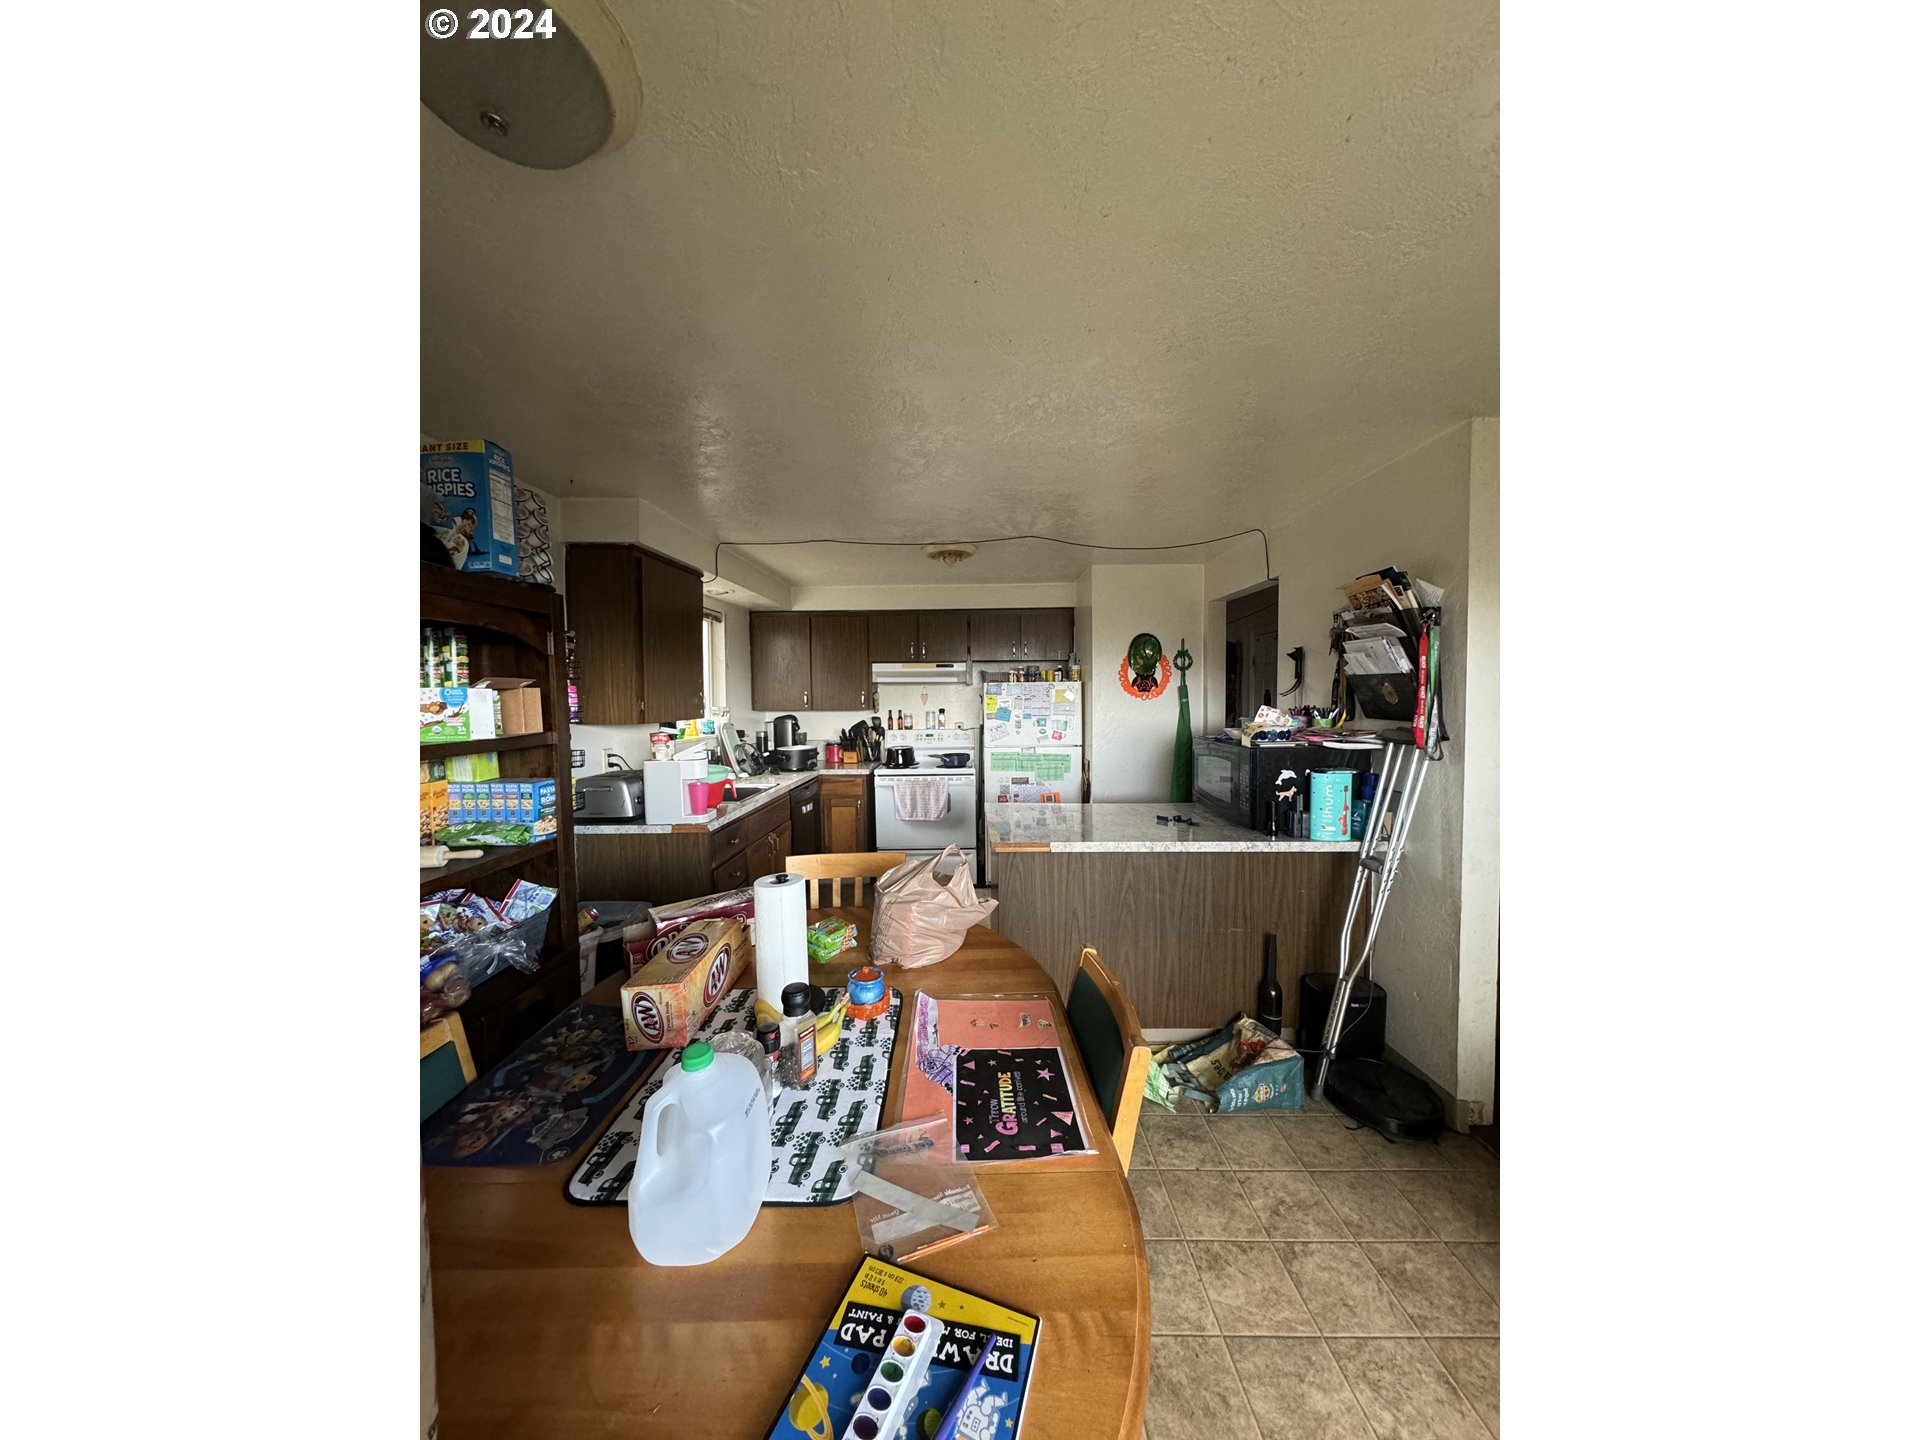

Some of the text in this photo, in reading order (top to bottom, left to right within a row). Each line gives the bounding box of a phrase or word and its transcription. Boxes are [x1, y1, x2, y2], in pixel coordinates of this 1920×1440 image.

[446, 441, 470, 451] SIZE
[427, 468, 462, 483] RICE
[427, 482, 476, 498] ISPIES
[541, 795, 556, 804] RON
[634, 1003, 661, 1032] A&W
[860, 1279, 888, 1298] 40 sheets
[840, 1322, 887, 1348] PAD
[848, 1308, 1013, 1348] IDEL FOR & PAINT
[932, 1340, 1015, 1374] DRAW
